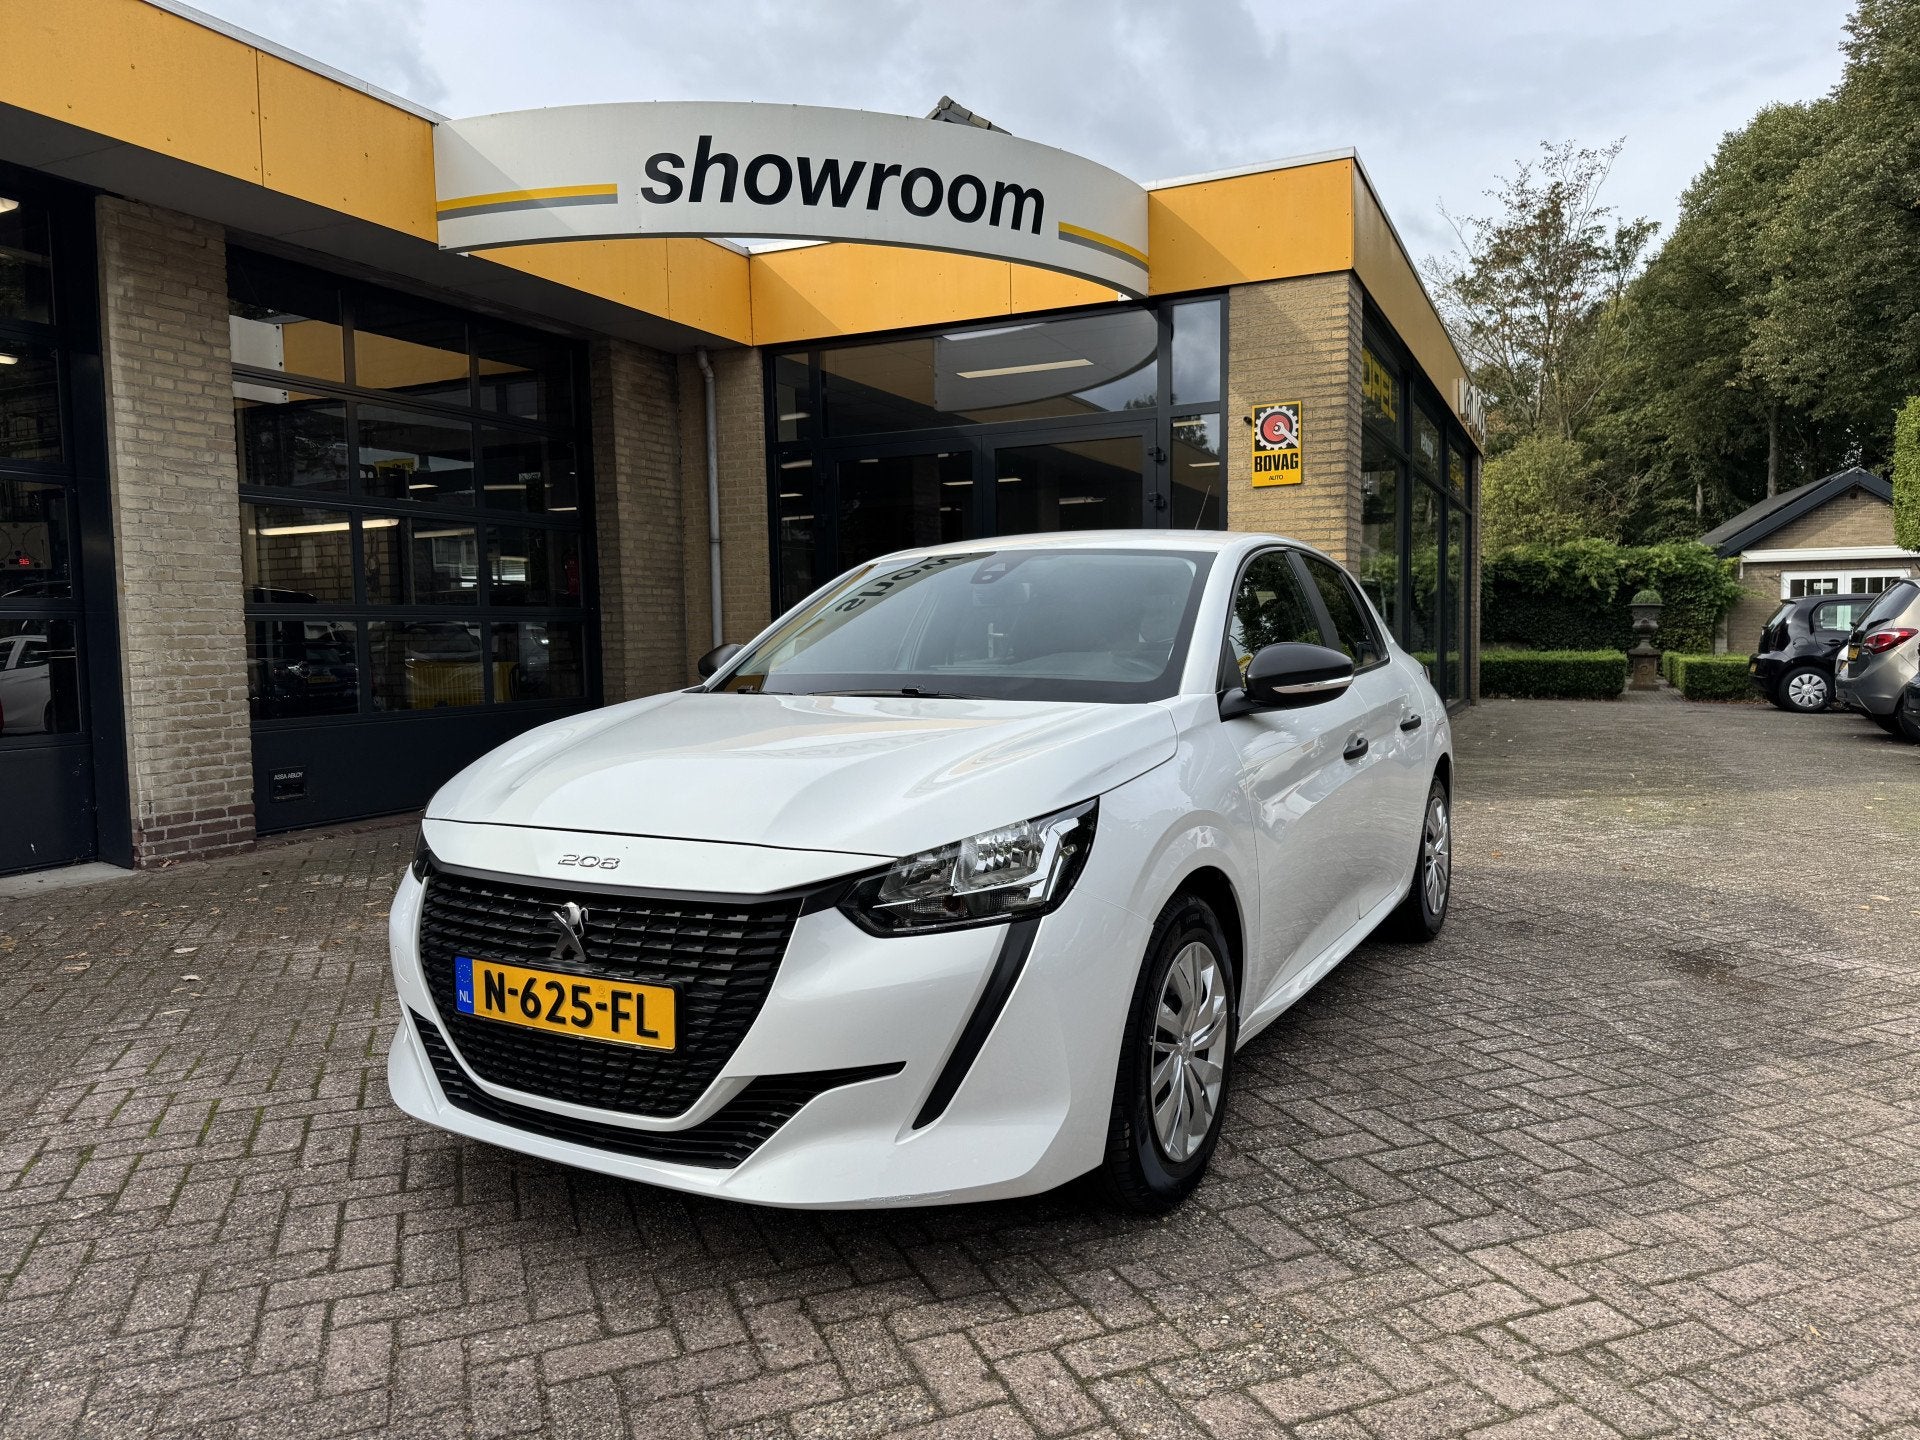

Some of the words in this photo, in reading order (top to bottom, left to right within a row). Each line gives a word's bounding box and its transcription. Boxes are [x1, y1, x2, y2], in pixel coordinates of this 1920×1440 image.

[640, 135, 1045, 235] showroom
[1254, 452, 1299, 472] BOVAG
[557, 854, 621, 870] 208
[459, 989, 472, 1004] NL
[484, 969, 659, 1039] N-625-FL
